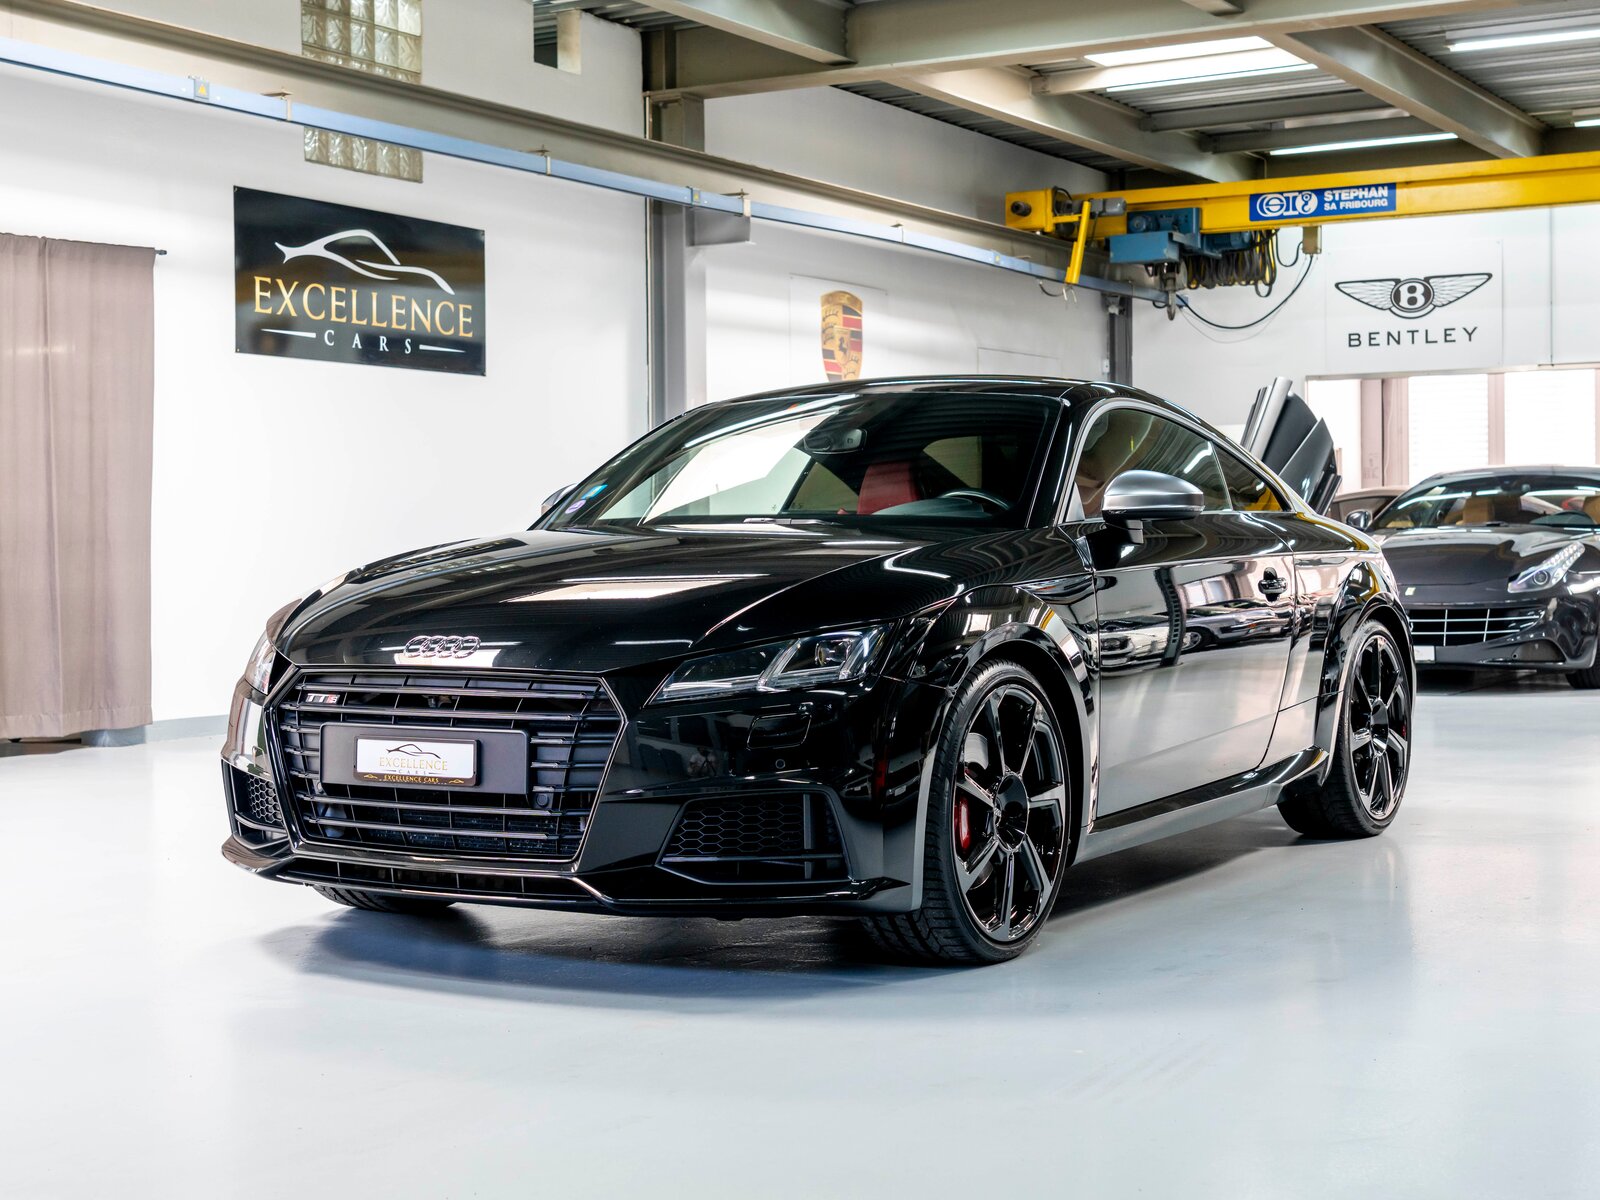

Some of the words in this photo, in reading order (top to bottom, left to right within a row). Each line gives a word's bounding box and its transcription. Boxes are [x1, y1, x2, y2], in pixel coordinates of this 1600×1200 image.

[1324, 186, 1388, 201] STEPHAN
[1324, 202, 1337, 211] SA
[1340, 198, 1388, 209] FRIBOURG
[254, 276, 473, 337] EXCELLENCE
[324, 330, 412, 354] CARS
[1348, 326, 1478, 347] BENTLEY
[306, 693, 340, 704] TTS
[379, 756, 448, 771] EXCELLENCE
[384, 774, 421, 783] EXCELLENCE
